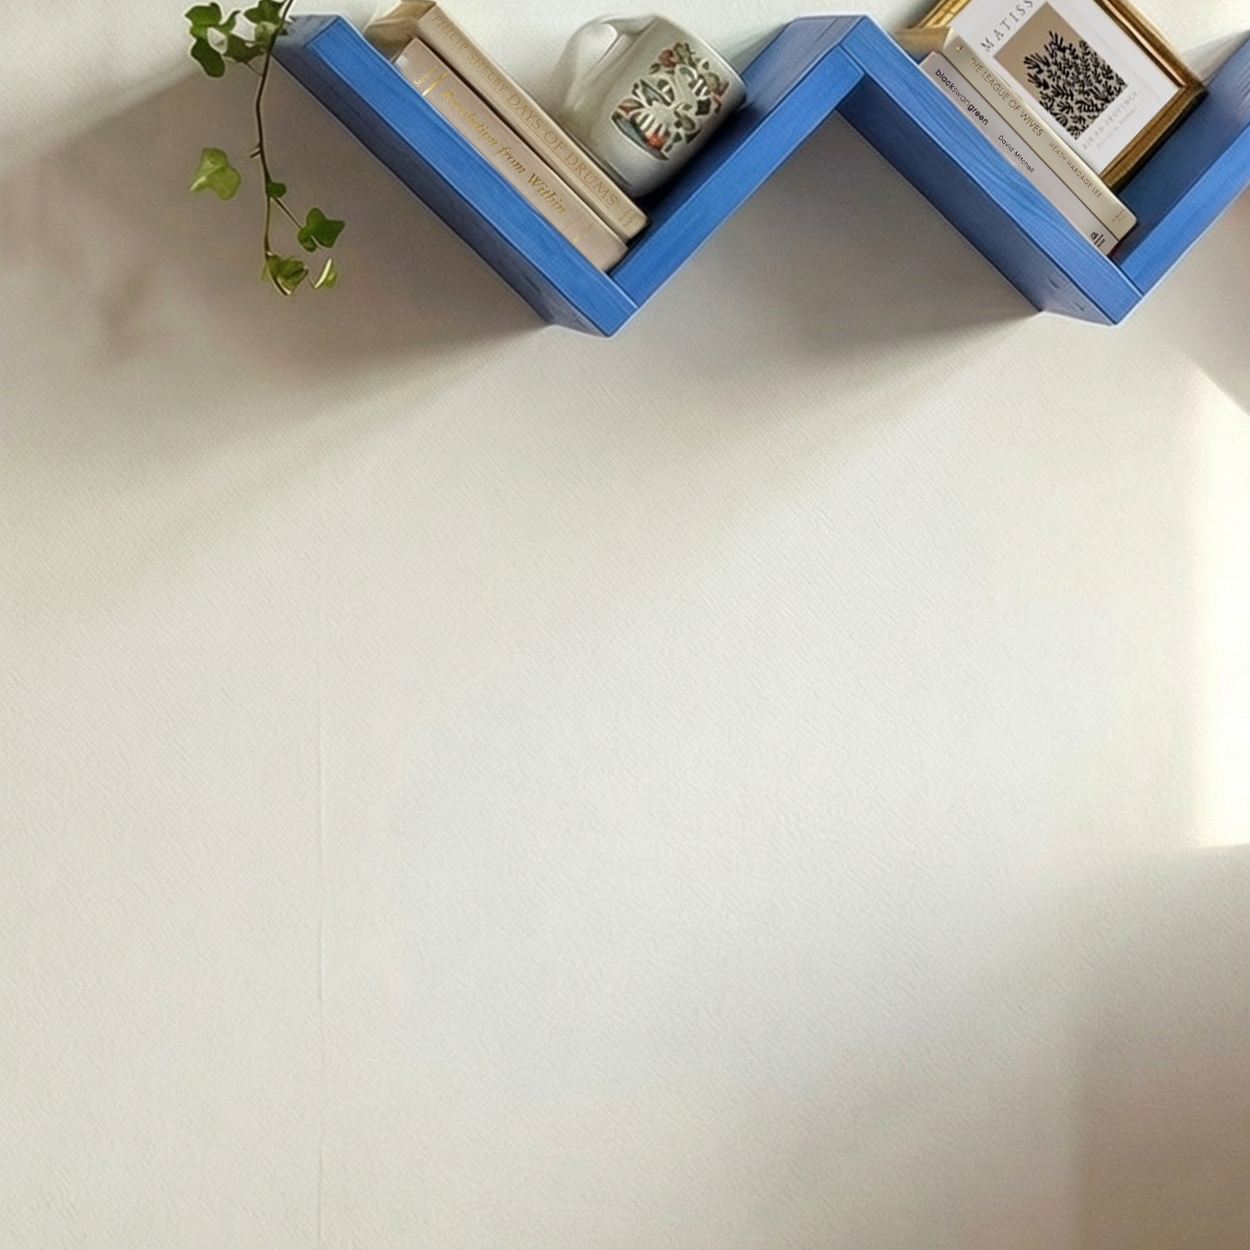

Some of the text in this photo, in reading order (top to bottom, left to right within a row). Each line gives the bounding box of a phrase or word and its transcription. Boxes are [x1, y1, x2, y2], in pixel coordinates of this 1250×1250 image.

[432, 15, 469, 50] PHILIP
[467, 51, 509, 92] SHELBY
[507, 92, 545, 130] DAYS
[543, 130, 567, 151] OF
[564, 152, 619, 206] DRUMS
[935, 68, 989, 126] blackswangreen
[968, 57, 1044, 137] THE LEAGUE OF WIVES
[440, 88, 567, 214] Revolution from Within
[997, 134, 1035, 174] David Mitchell
[1048, 141, 1103, 199] HEATH HARDAGE LEE
